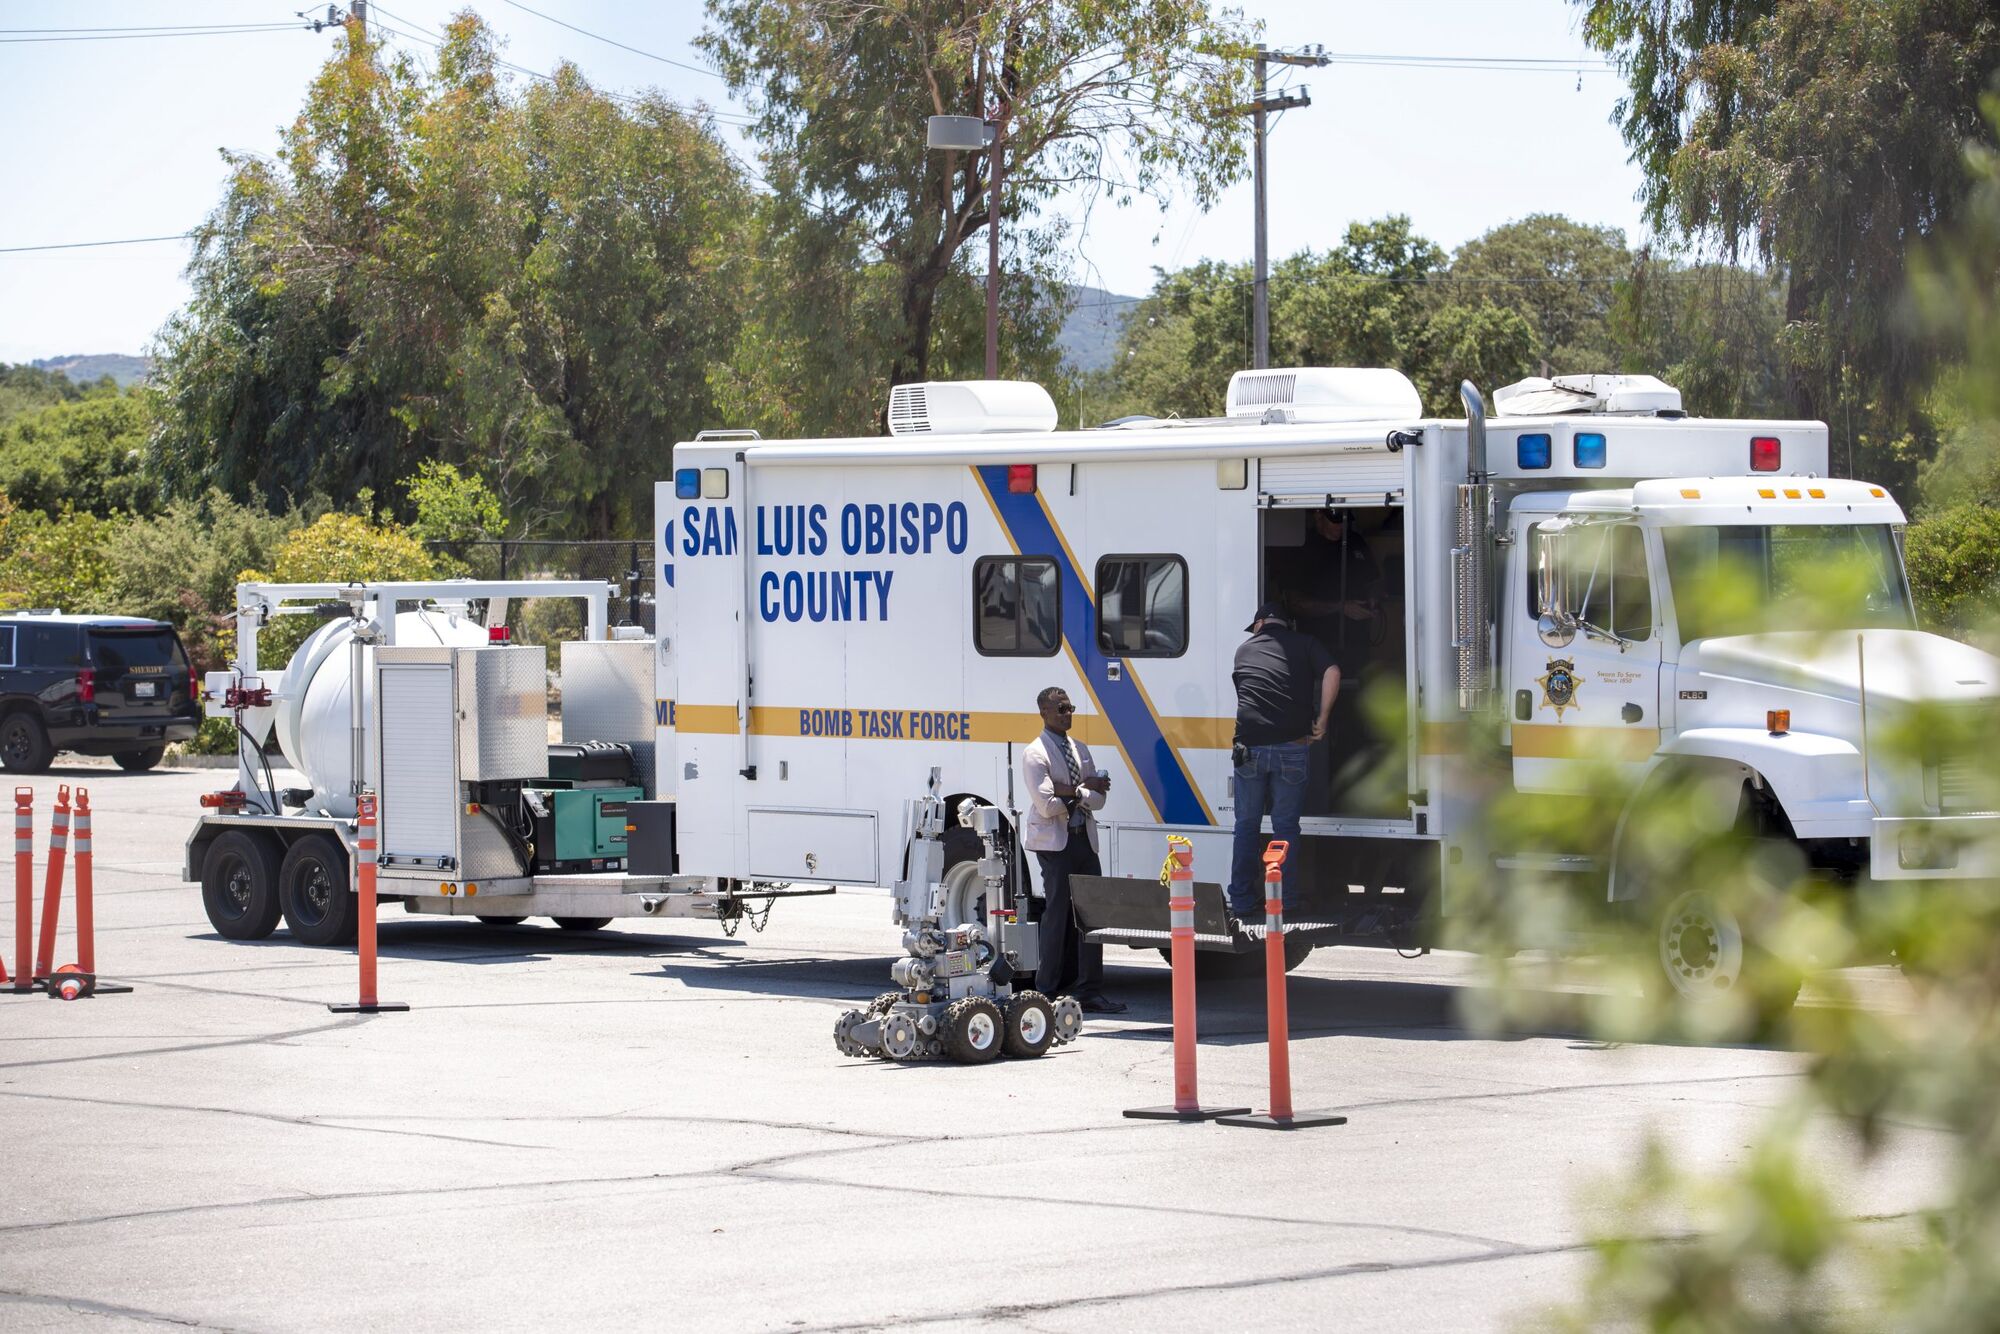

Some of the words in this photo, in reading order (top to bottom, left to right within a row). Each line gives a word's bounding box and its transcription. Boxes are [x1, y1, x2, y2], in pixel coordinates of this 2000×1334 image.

[683, 506, 738, 557] SAN
[757, 503, 828, 556] LUIS
[841, 501, 968, 555] OBISPO
[760, 570, 894, 623] COUNTY
[800, 709, 853, 737] BOMB
[859, 711, 904, 739] TASK
[910, 712, 971, 741] FORCE
